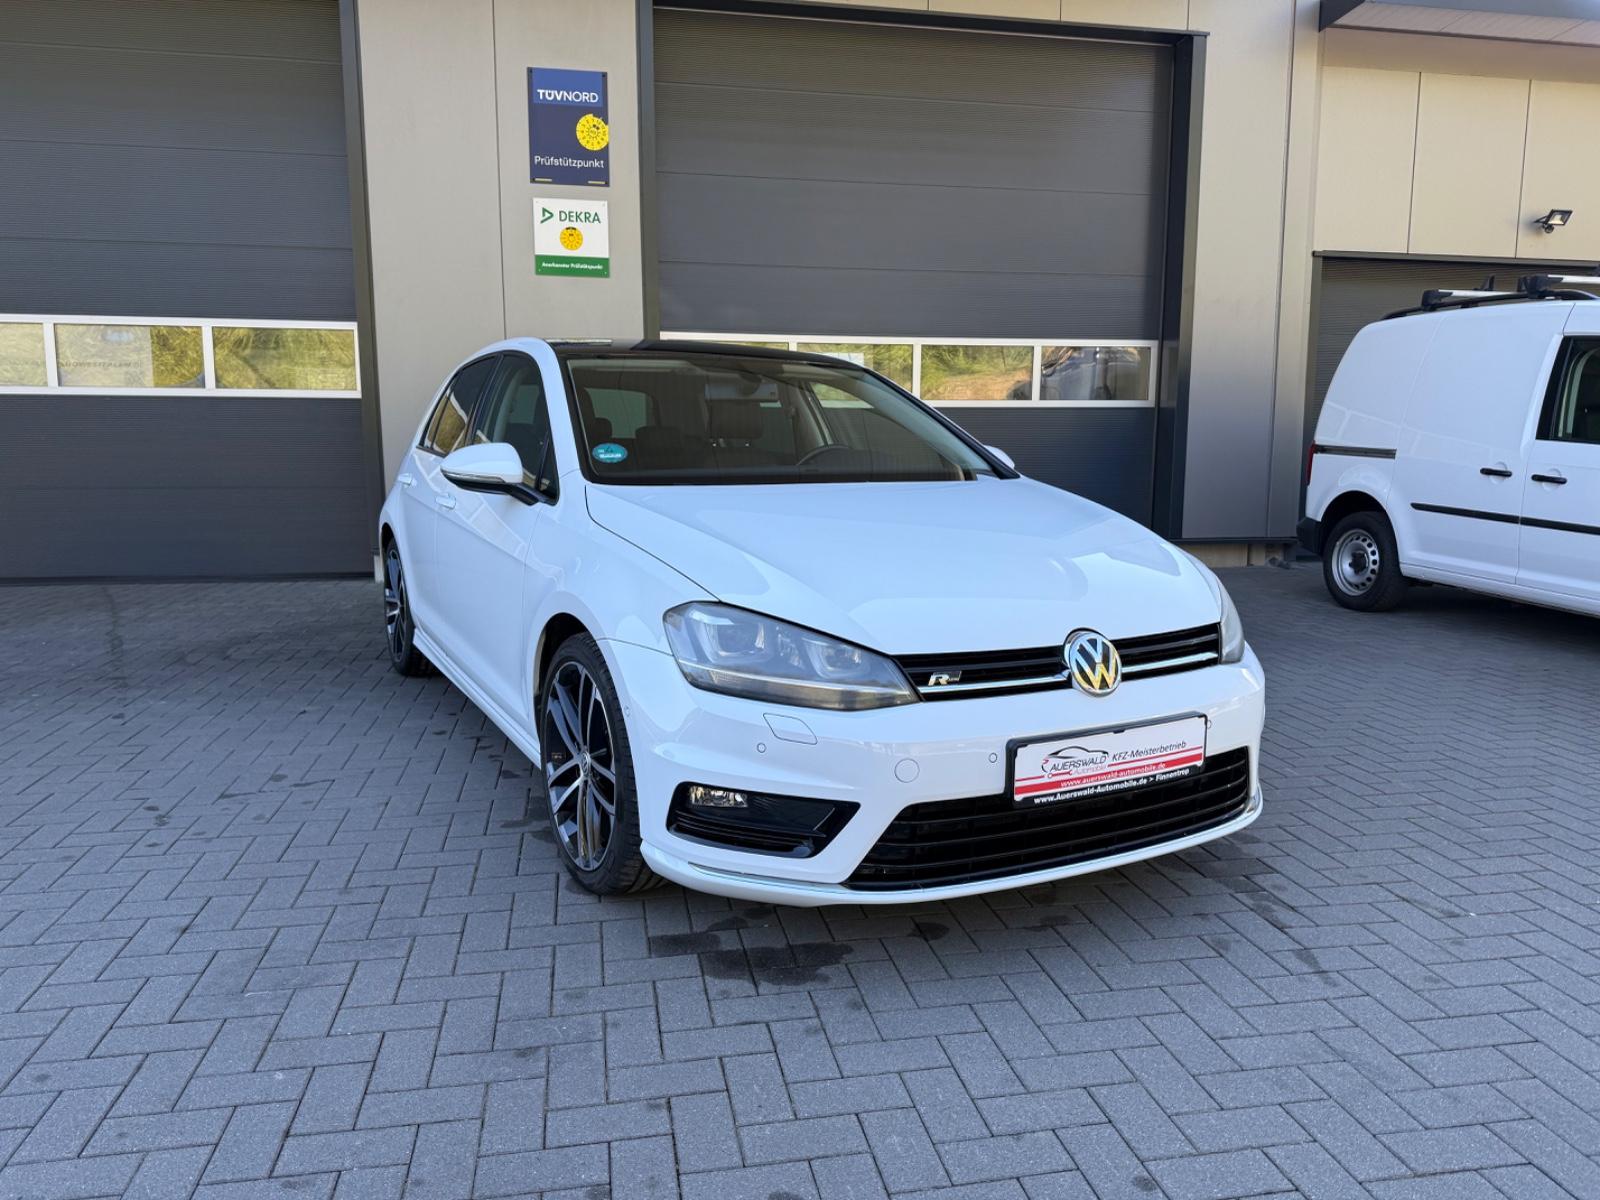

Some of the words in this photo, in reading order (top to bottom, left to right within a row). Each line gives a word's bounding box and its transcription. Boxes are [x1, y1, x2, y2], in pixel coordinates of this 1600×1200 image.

[534, 155, 604, 169] Prüfstützpunkt
[558, 210, 601, 224] DEKRA
[1070, 635, 1117, 690] VW
[1050, 755, 1107, 772] AUERSWALD
[1111, 741, 1187, 762] KFZ-Meisterbetrieb
[1034, 778, 1148, 804] www.Auerswald-Automobile.de
[1155, 767, 1190, 782] Finnentrop
[1060, 762, 1166, 787] www.auerswald-automobile.de
